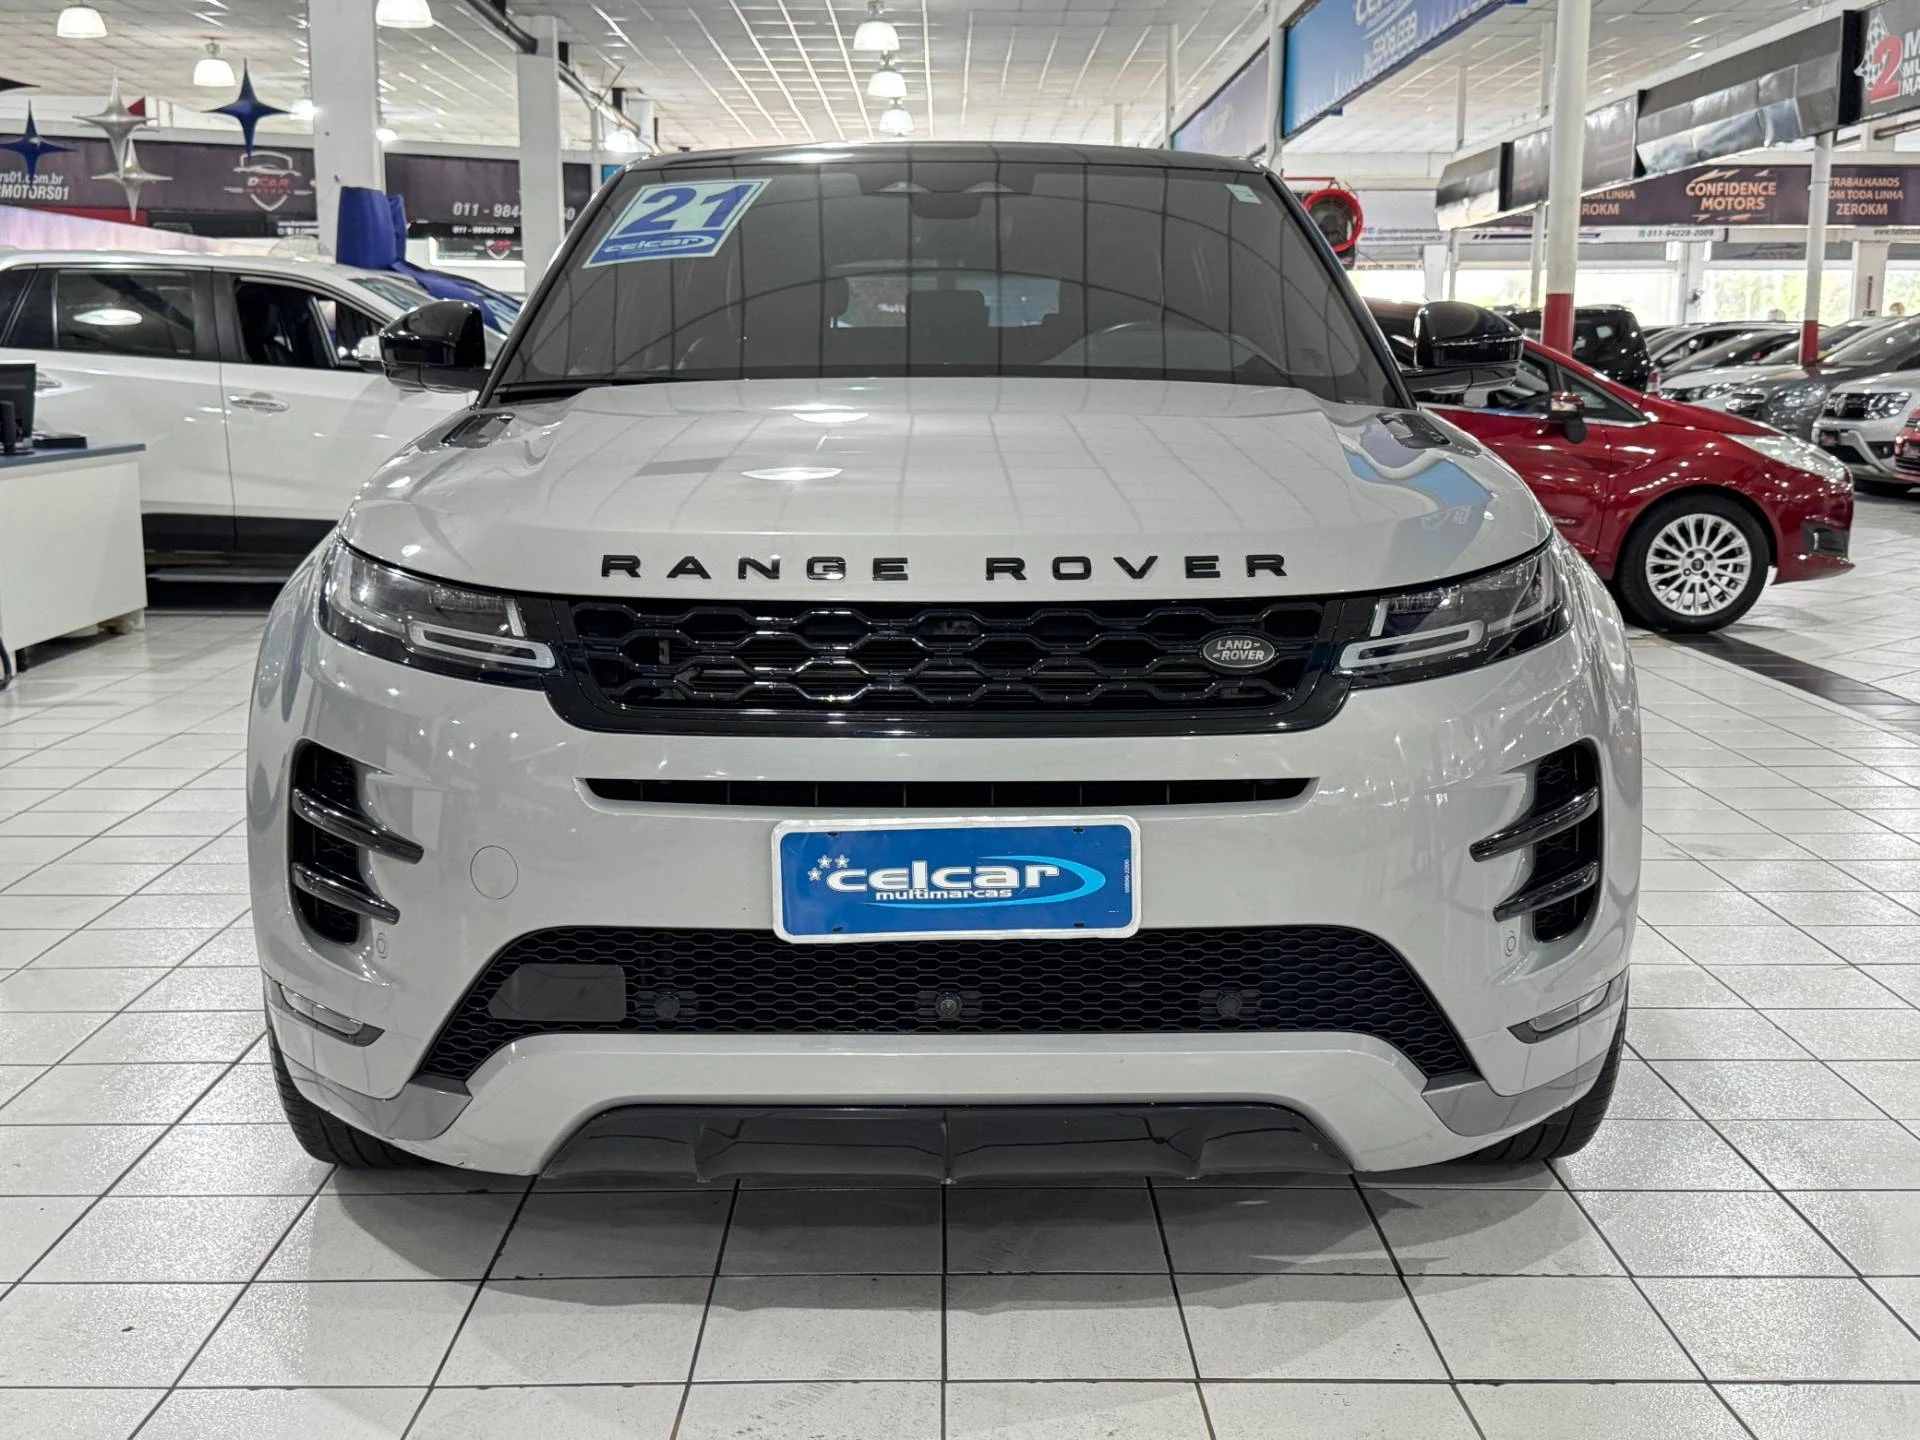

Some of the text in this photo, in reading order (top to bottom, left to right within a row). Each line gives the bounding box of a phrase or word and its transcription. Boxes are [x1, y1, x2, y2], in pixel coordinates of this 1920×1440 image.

[0, 184, 69, 200] MOTORS01
[1685, 182, 1776, 196] CONFIDENCE
[1847, 190, 1873, 200] TODA
[1875, 190, 1904, 200] LINHA
[452, 202, 479, 217] 011
[493, 203, 522, 218] 984
[617, 184, 755, 236] 21
[1582, 203, 1620, 216] ROKM
[1700, 197, 1766, 211] MOTORS
[1836, 203, 1888, 215] ZEROKM
[604, 236, 700, 253] celcar
[601, 553, 1288, 582] RANGE ROVER
[1216, 640, 1253, 650] LAND
[1221, 650, 1265, 661] ROVER
[825, 859, 1060, 893] celcar
[875, 887, 1013, 901] multimarcas
